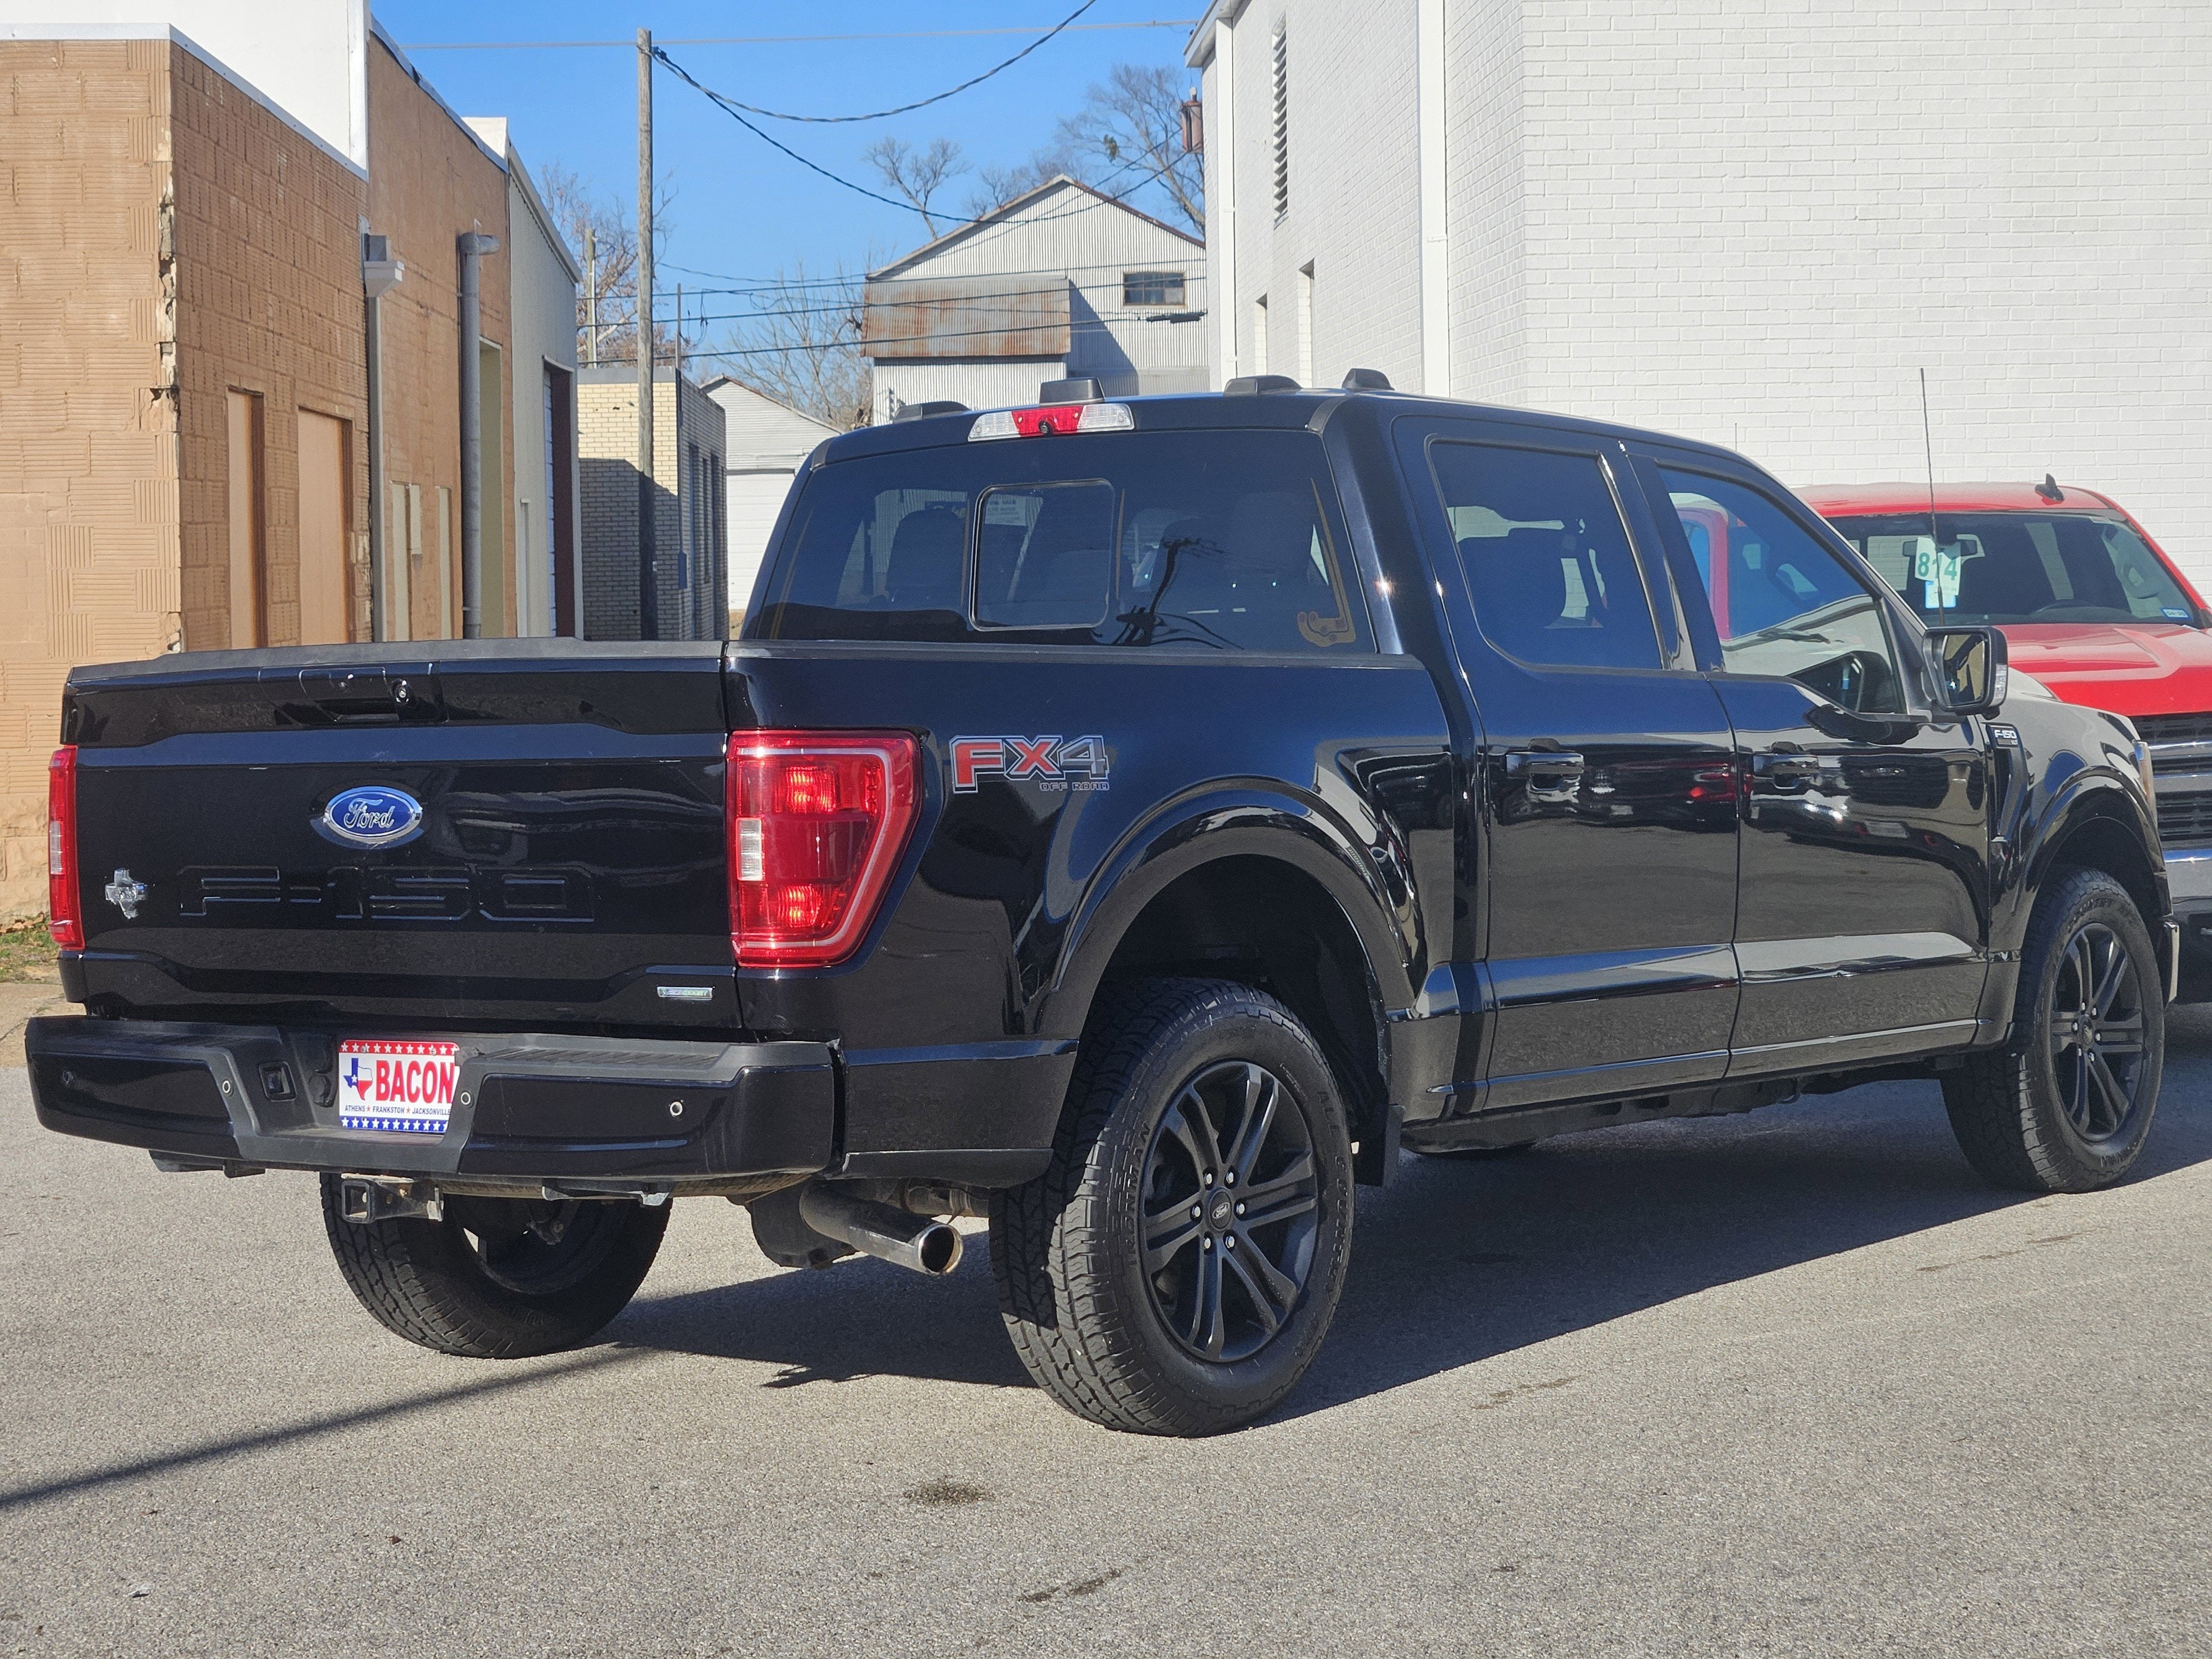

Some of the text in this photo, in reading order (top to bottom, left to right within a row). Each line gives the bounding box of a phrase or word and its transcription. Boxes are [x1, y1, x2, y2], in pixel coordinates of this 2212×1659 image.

[1918, 552, 1958, 581] 814
[1994, 729, 2017, 739] F-150
[949, 735, 1110, 794] FX4
[1039, 781, 1110, 791] OFF ROAD
[344, 797, 395, 830] Ford
[177, 864, 595, 922] F-150
[375, 1060, 455, 1104] BACON
[345, 1104, 366, 1113] ATHENS
[411, 1107, 451, 1116] JACKSONVILLE
